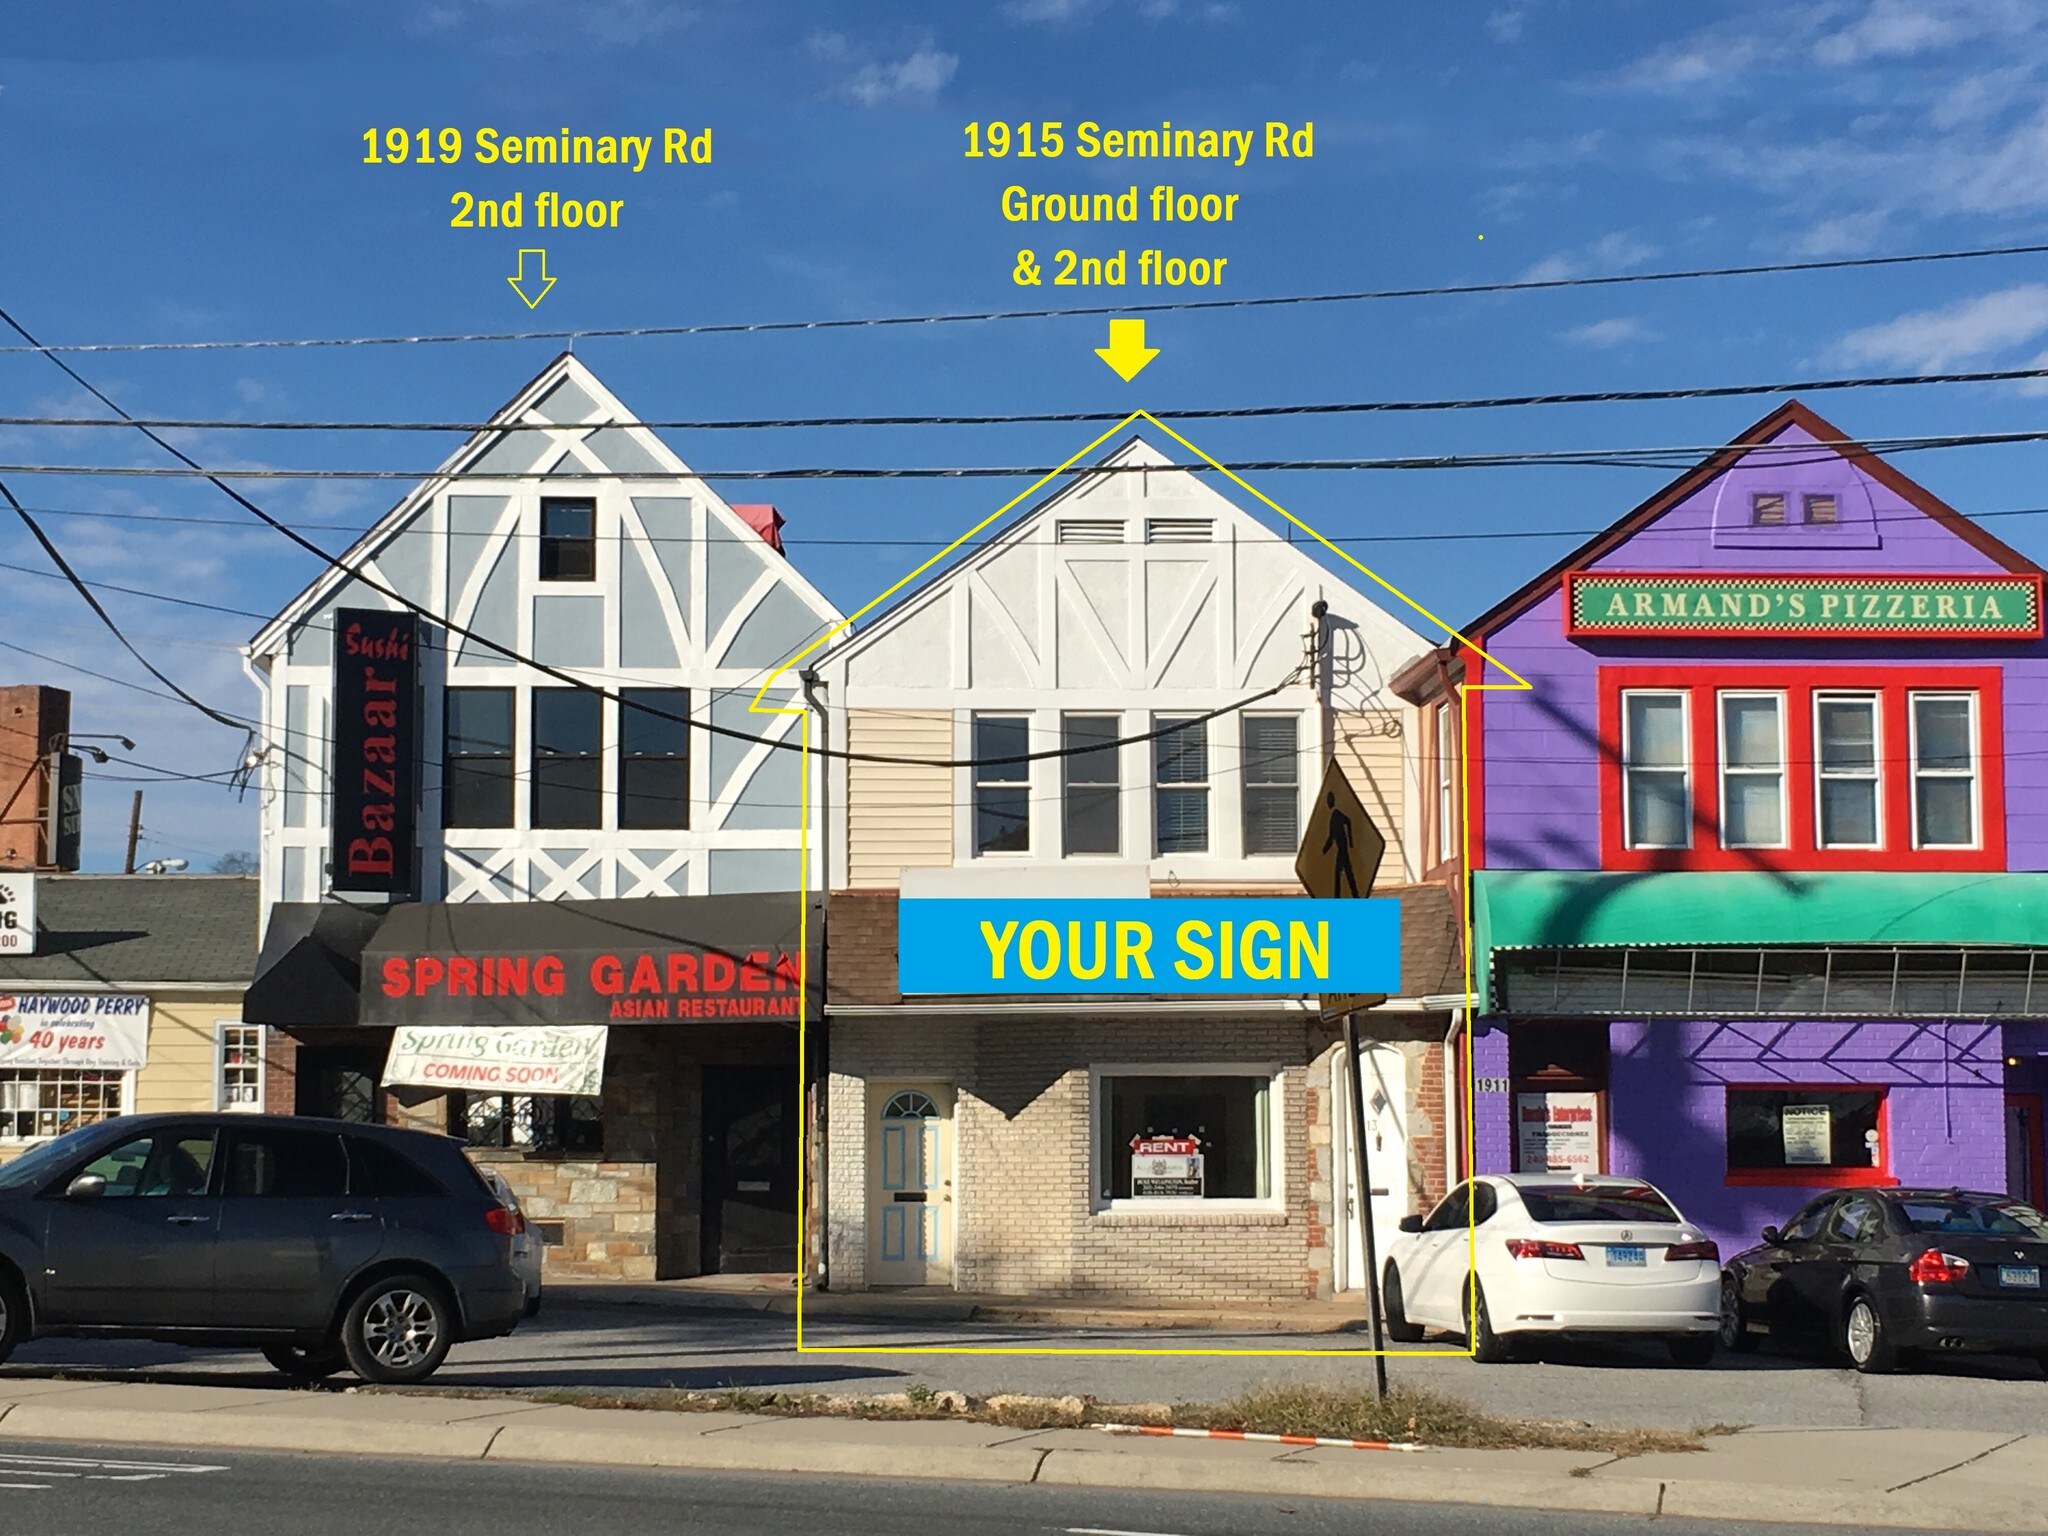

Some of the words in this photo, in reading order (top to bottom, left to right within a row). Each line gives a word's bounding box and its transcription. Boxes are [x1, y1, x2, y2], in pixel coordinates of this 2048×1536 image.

[1605, 592, 1806, 618] ARMAND'S
[1820, 593, 2003, 619] PIZZERIA
[345, 621, 410, 662] Sushi
[348, 665, 398, 880] Bazaar
[381, 955, 566, 998] SPRING
[590, 951, 808, 994] GARDEN
[18, 995, 91, 1014] HAYWOOD
[94, 997, 146, 1016] PERRY
[609, 998, 669, 1019] ASIAN
[677, 996, 807, 1018] RESTAURANT
[28, 1030, 54, 1049] 40
[58, 1035, 105, 1055] years
[401, 1030, 489, 1057] Spring
[496, 1032, 594, 1058] Garden
[423, 1063, 500, 1082] COMING
[506, 1066, 560, 1084] SOON
[1477, 1078, 1508, 1092] 1911
[1784, 1106, 1827, 1116] NOTICE
[1140, 1142, 1190, 1153] RENT
